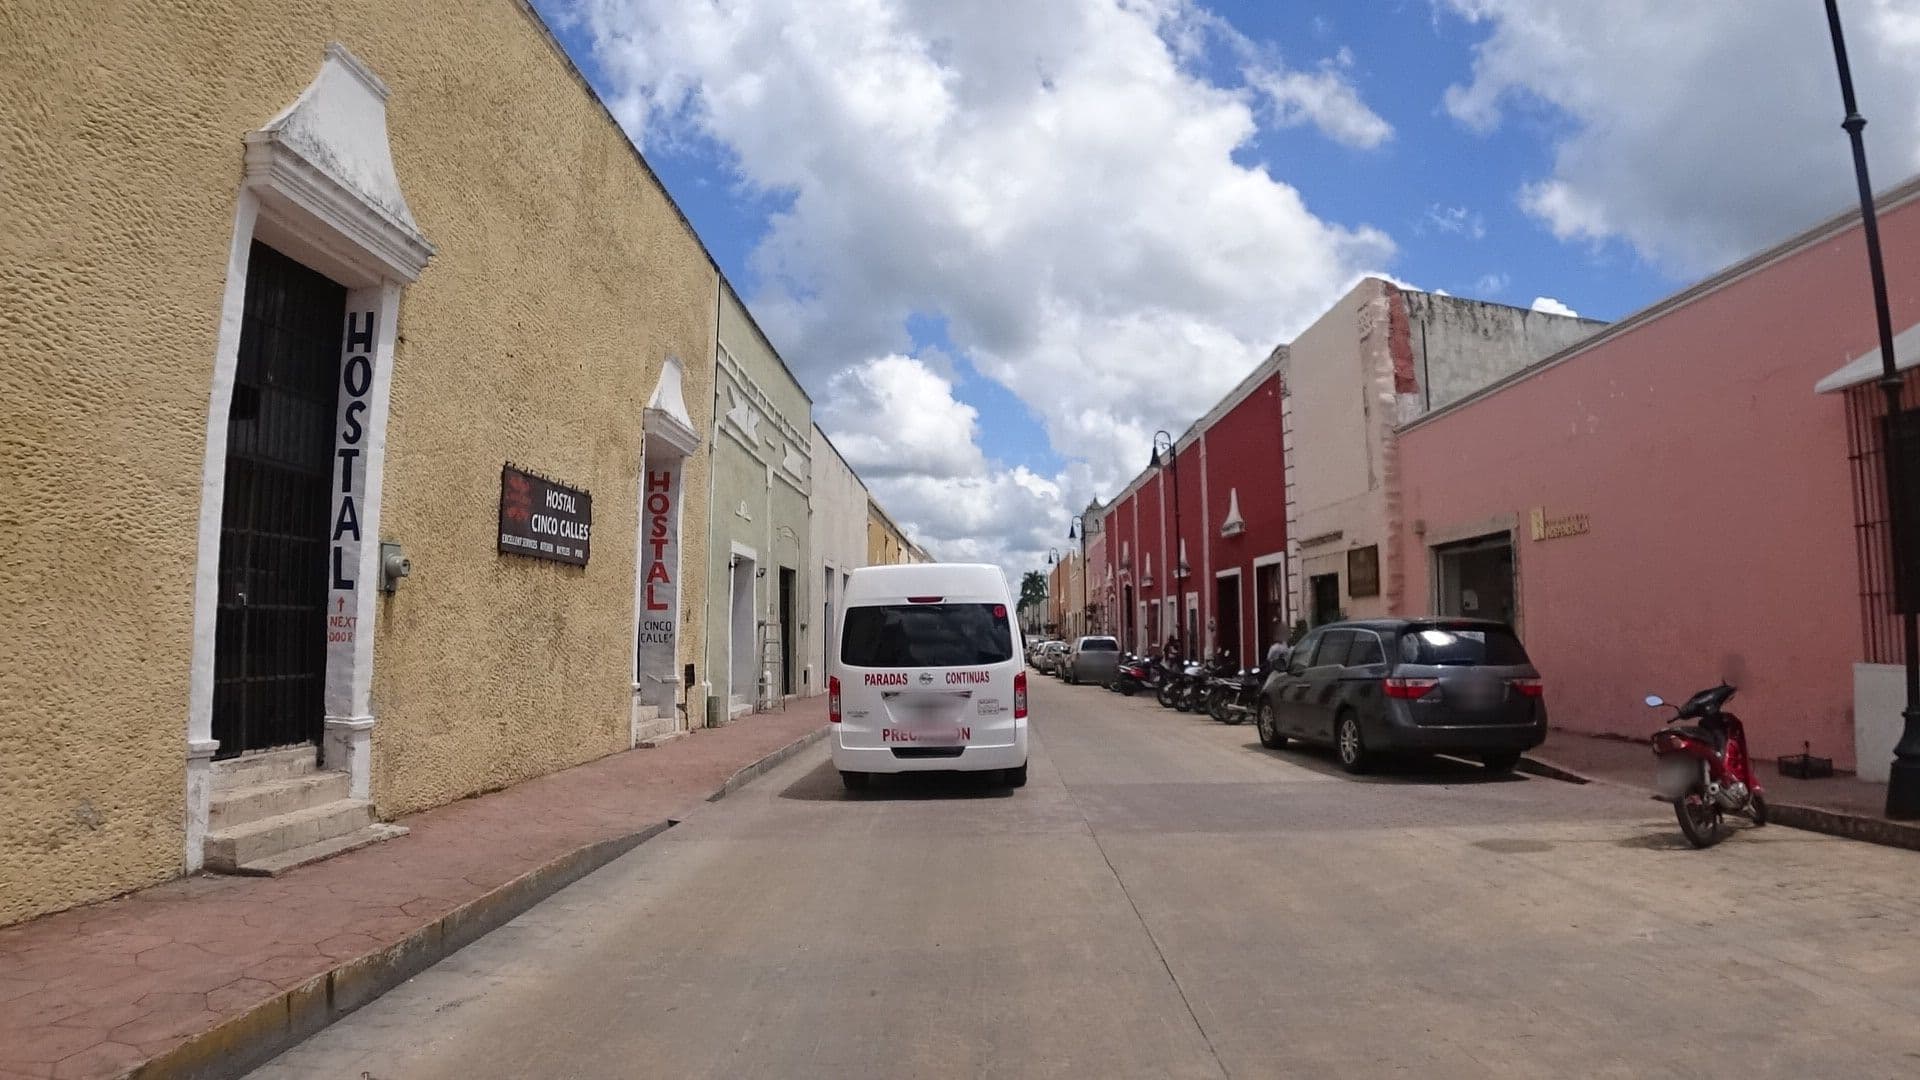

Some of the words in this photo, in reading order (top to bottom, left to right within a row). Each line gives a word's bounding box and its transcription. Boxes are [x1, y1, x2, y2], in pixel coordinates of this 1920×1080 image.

[332, 311, 374, 590] HOSTAL
[546, 489, 576, 513] HOSTAL
[531, 514, 558, 535] CINCO
[560, 519, 588, 540] CALLES
[647, 471, 670, 610] HOSTAL
[330, 616, 358, 628] NEXT
[644, 621, 672, 631] CINCO
[329, 632, 353, 642] DOOR
[864, 673, 908, 686] PARADAS
[945, 671, 990, 684] CONTINUAS
[882, 727, 971, 742] PRECN
